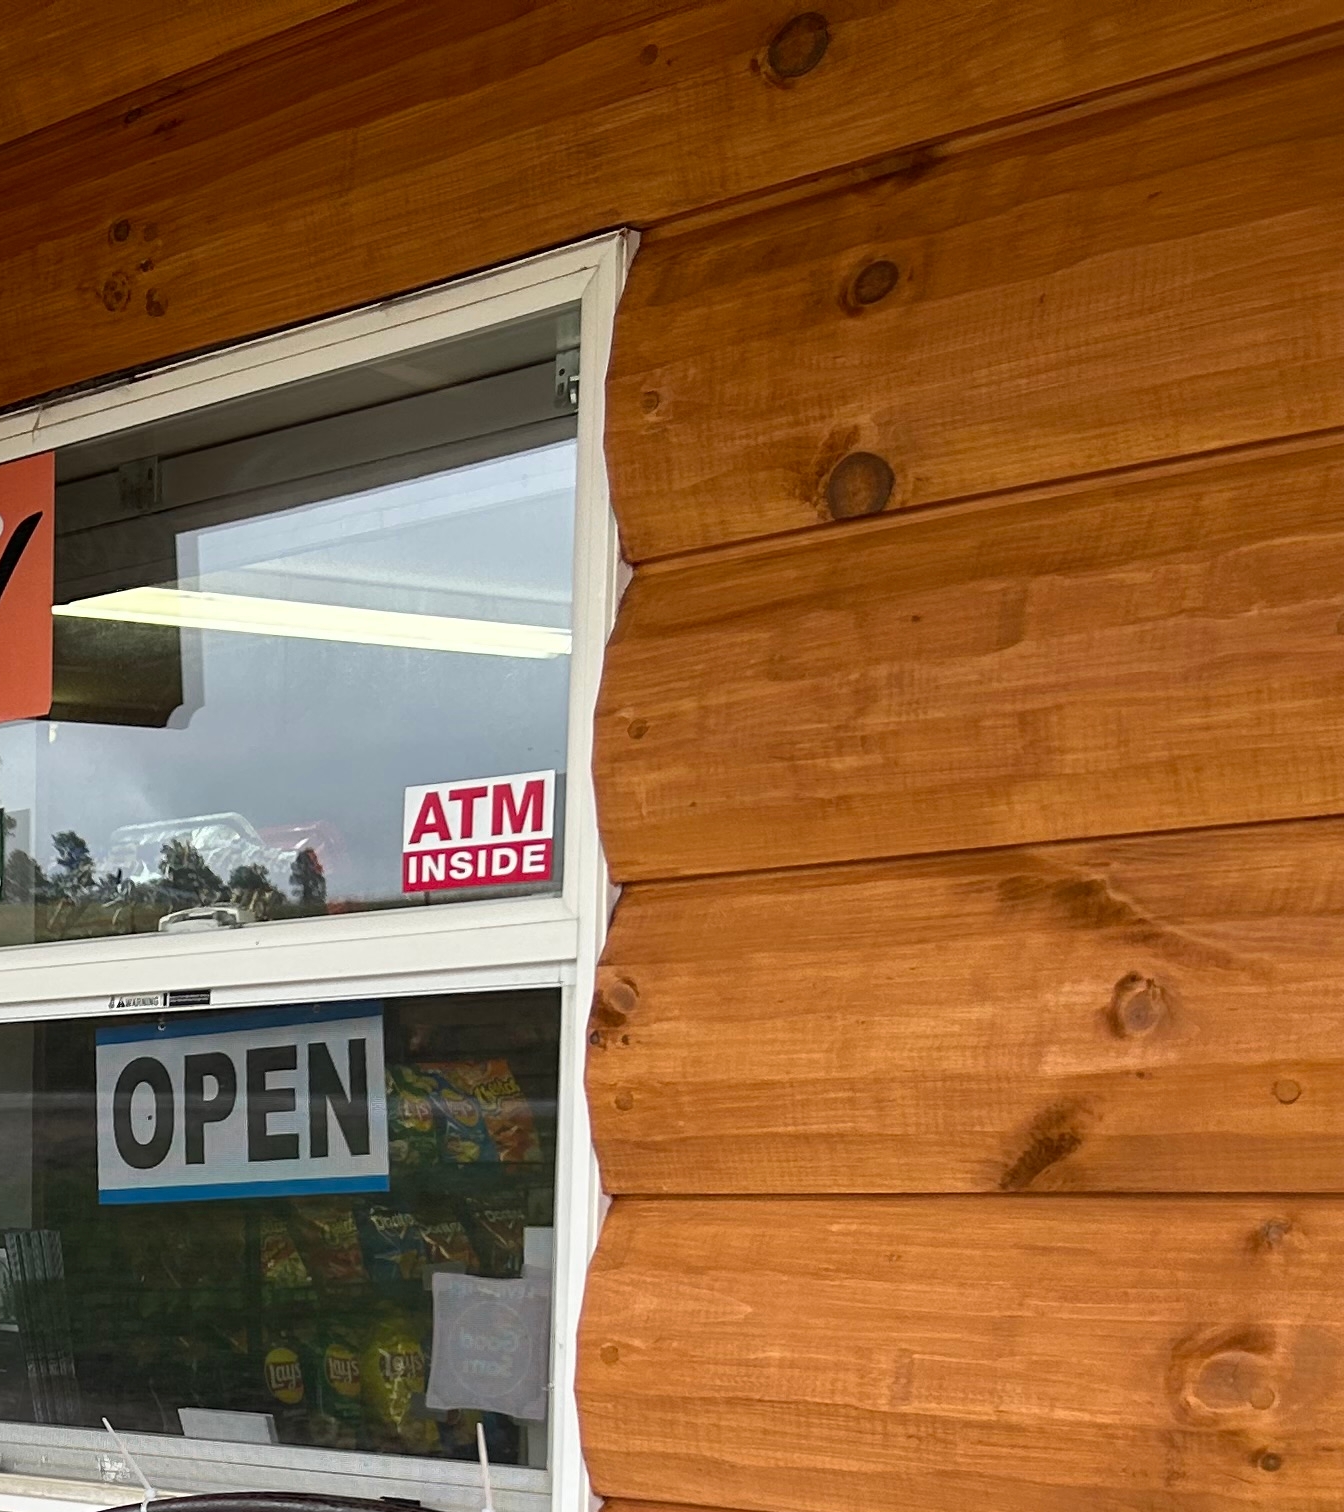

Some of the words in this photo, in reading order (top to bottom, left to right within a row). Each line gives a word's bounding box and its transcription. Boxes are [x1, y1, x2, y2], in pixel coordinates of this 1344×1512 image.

[408, 779, 545, 845] ATM
[408, 843, 546, 884] INSIDE
[113, 1038, 370, 1170] OPEN
